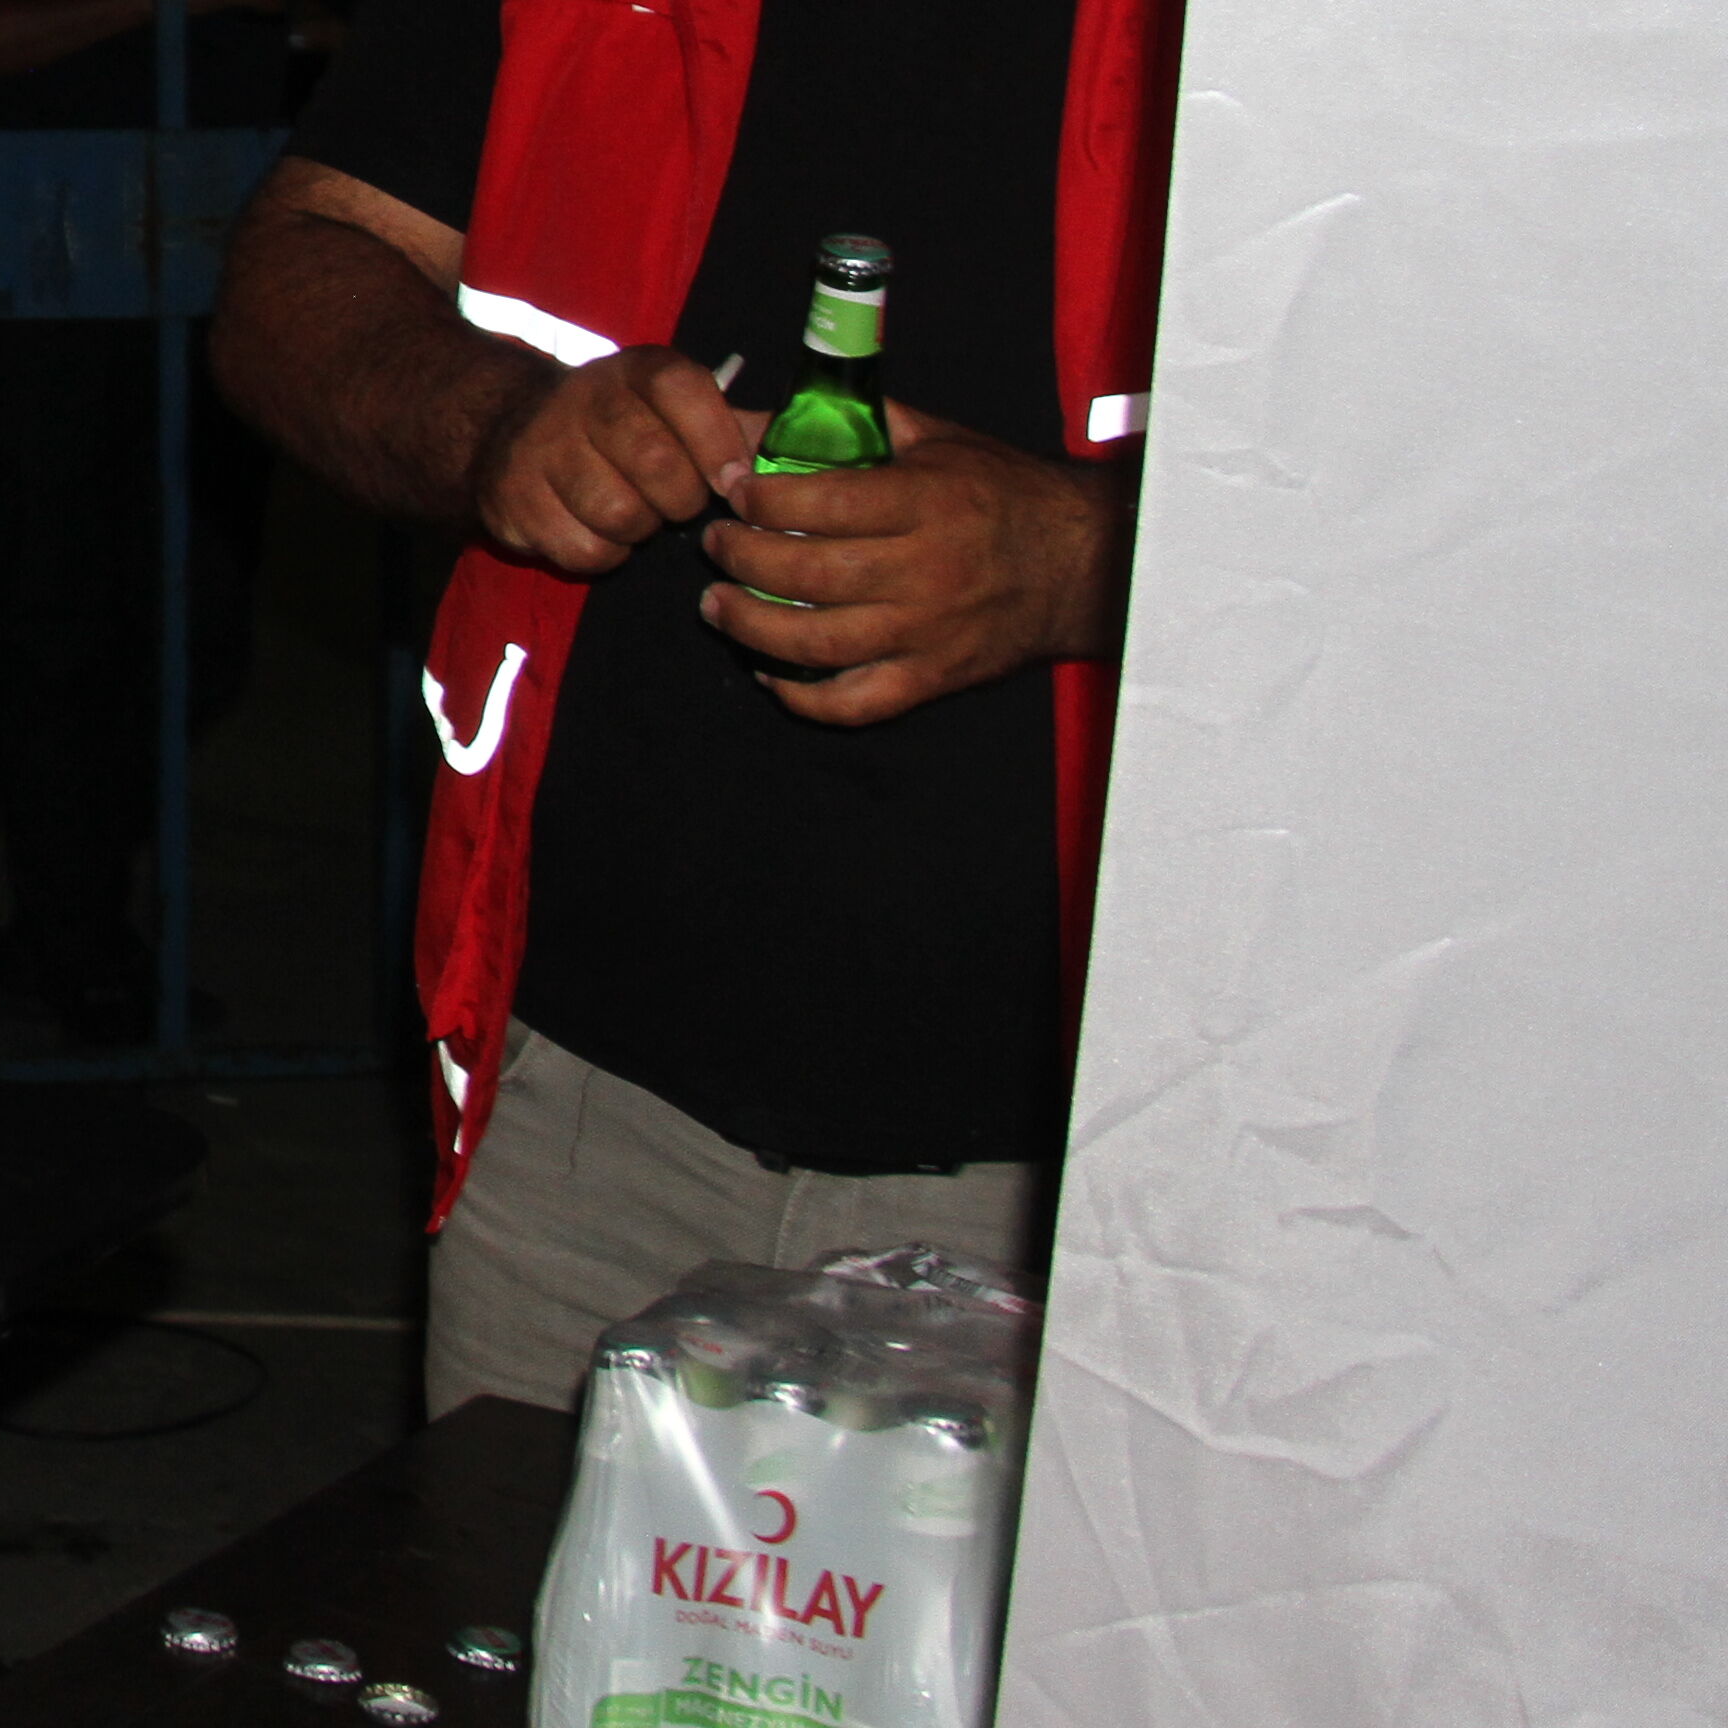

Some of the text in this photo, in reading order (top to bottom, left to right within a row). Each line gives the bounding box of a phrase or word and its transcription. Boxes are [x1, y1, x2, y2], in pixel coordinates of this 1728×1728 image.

[651, 1536, 885, 1639] KIZILAY
[809, 1636, 855, 1660] SUYU
[681, 1656, 843, 1722] ZENGİN
